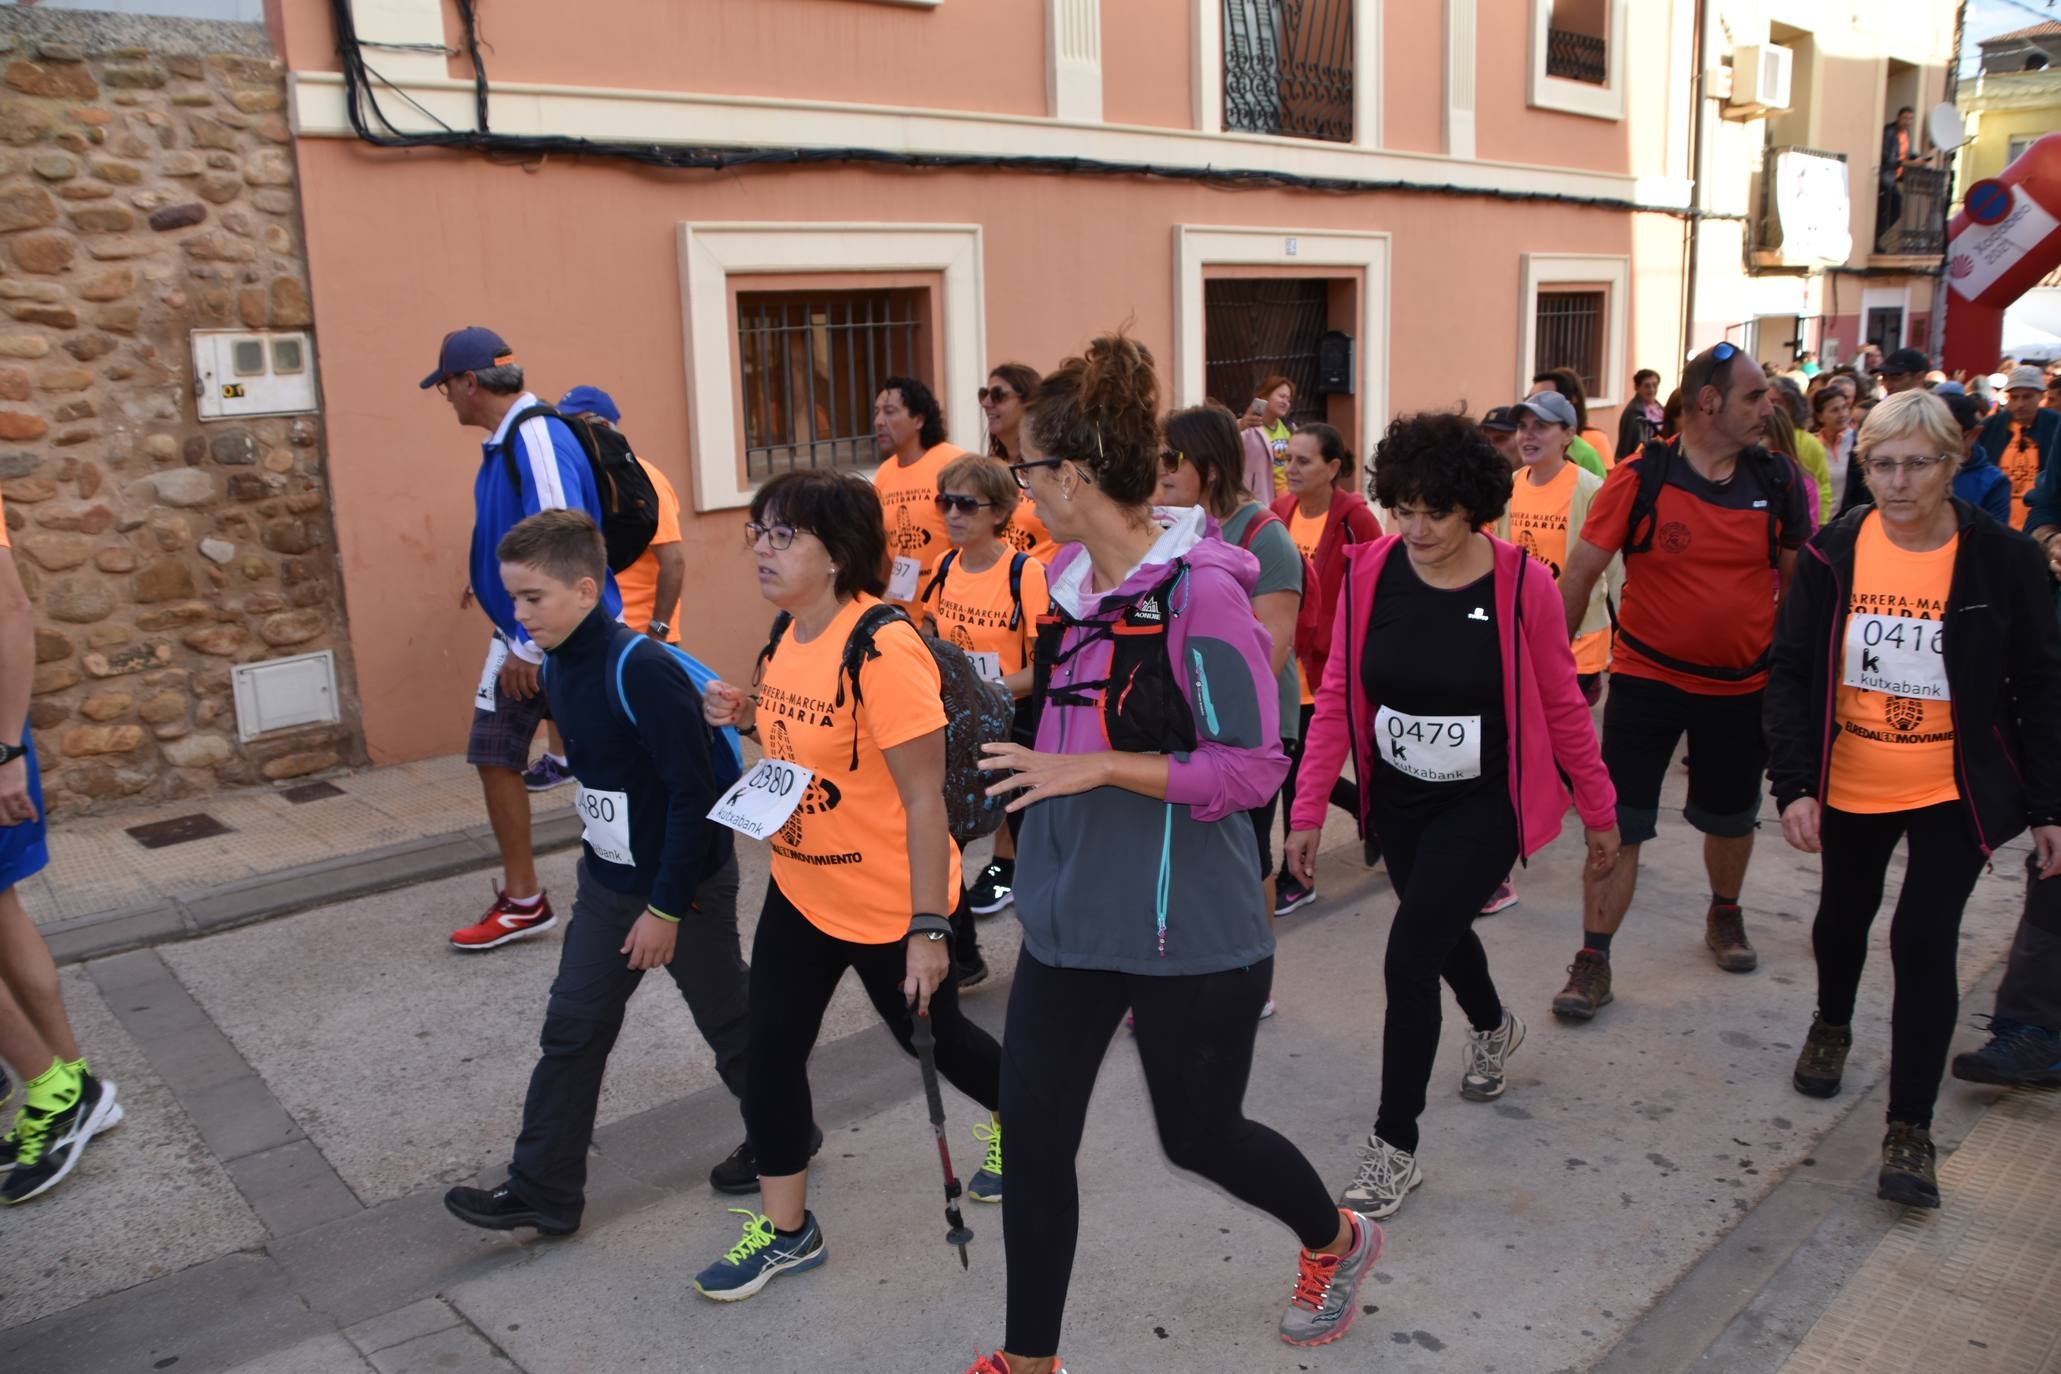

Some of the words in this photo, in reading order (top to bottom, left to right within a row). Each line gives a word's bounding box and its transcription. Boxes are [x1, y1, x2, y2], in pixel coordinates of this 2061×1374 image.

[895, 561, 911, 577] 97
[939, 607, 1008, 629] OLIDARIA
[1863, 619, 1945, 655] 0416
[1860, 672, 1942, 698] kutxabank
[757, 696, 834, 728] OLIDARIA
[1387, 716, 1466, 748] 0479
[749, 764, 794, 797] 0380
[1393, 757, 1465, 780] kutxabank
[716, 808, 766, 836] kutxabank
